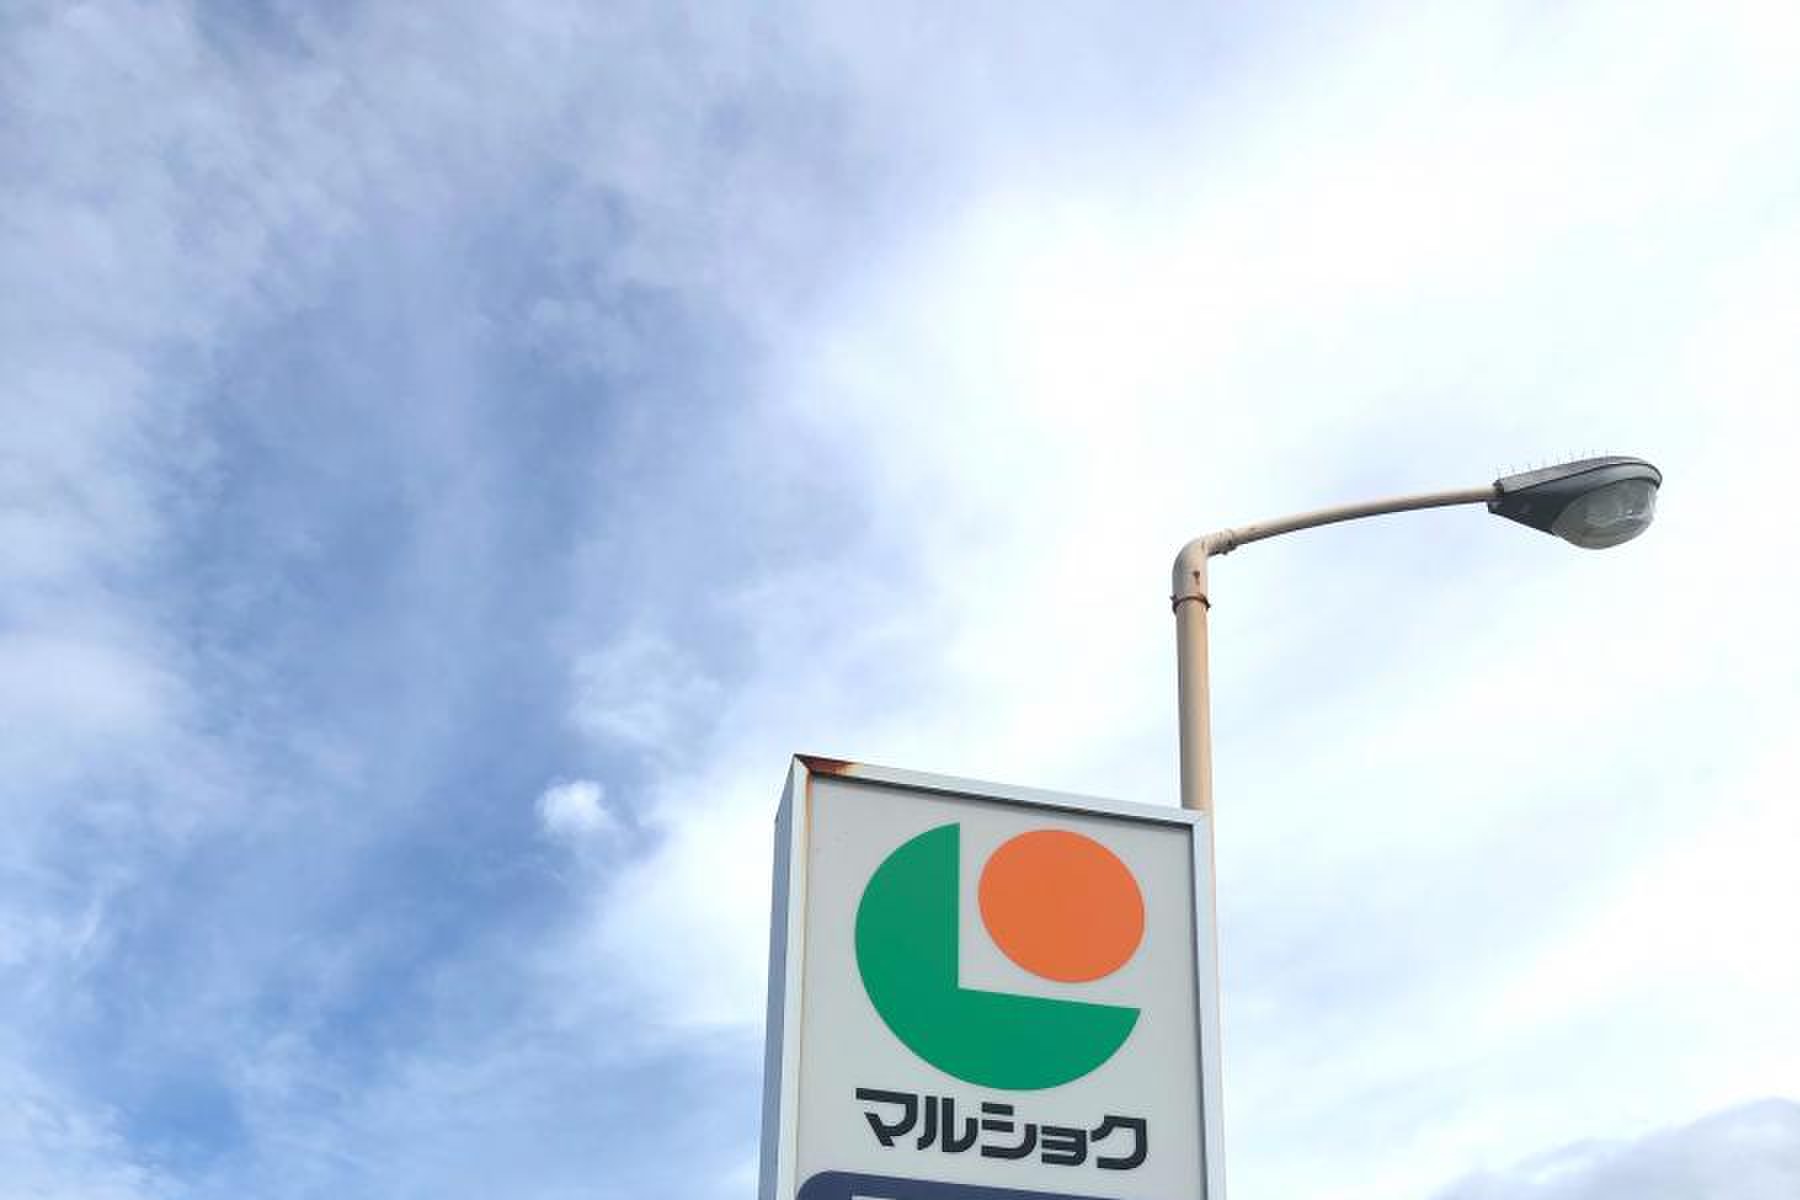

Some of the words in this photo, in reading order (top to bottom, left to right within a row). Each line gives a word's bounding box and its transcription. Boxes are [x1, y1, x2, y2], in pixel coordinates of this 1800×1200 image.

[855, 1087, 1147, 1170] マルショク
